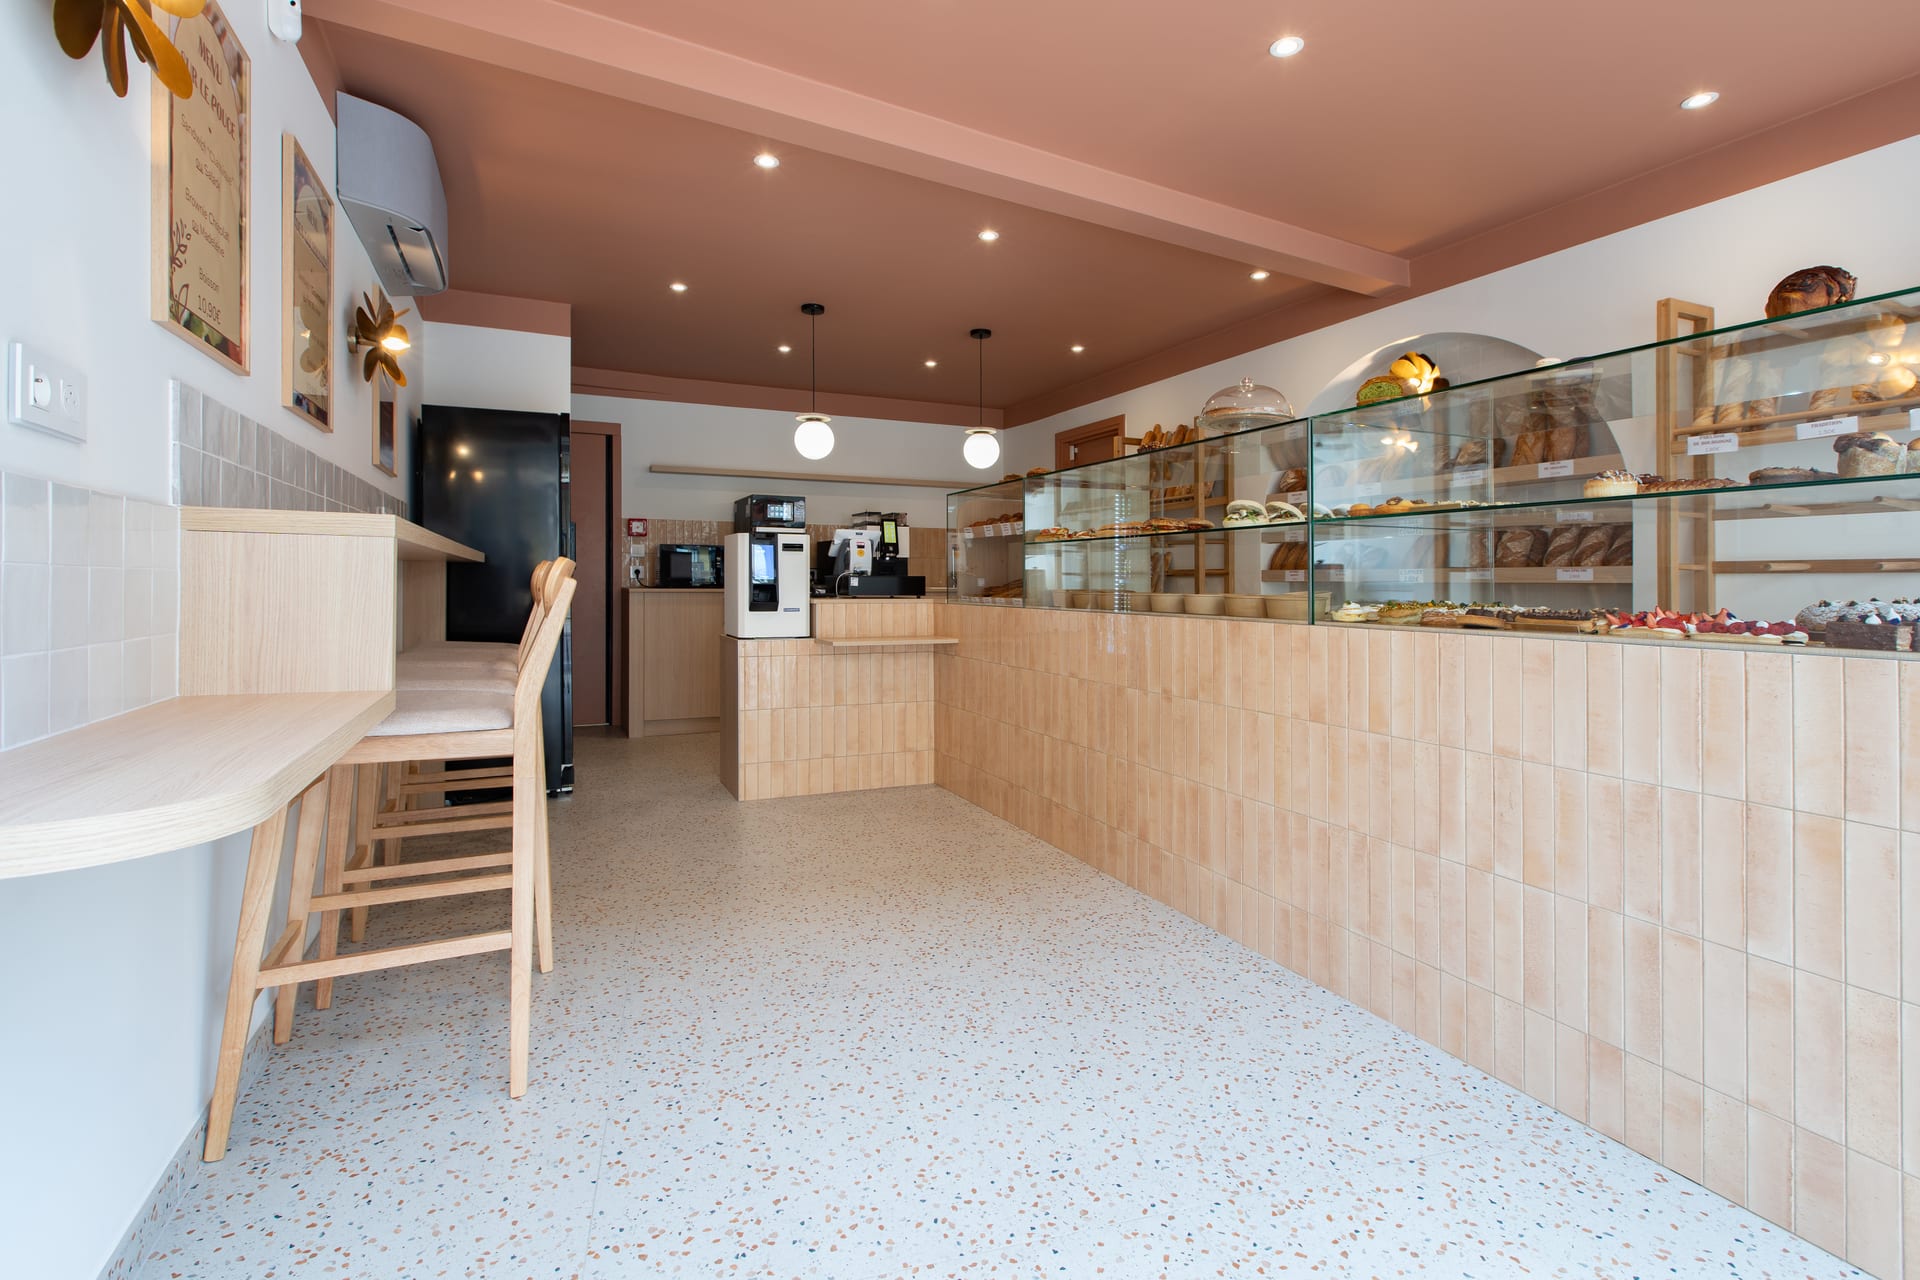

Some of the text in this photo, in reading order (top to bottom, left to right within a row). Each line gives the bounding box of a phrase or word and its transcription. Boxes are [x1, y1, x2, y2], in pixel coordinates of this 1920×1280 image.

[199, 35, 222, 86] MENU
[200, 77, 210, 106] LE
[211, 93, 236, 141] POUCE
